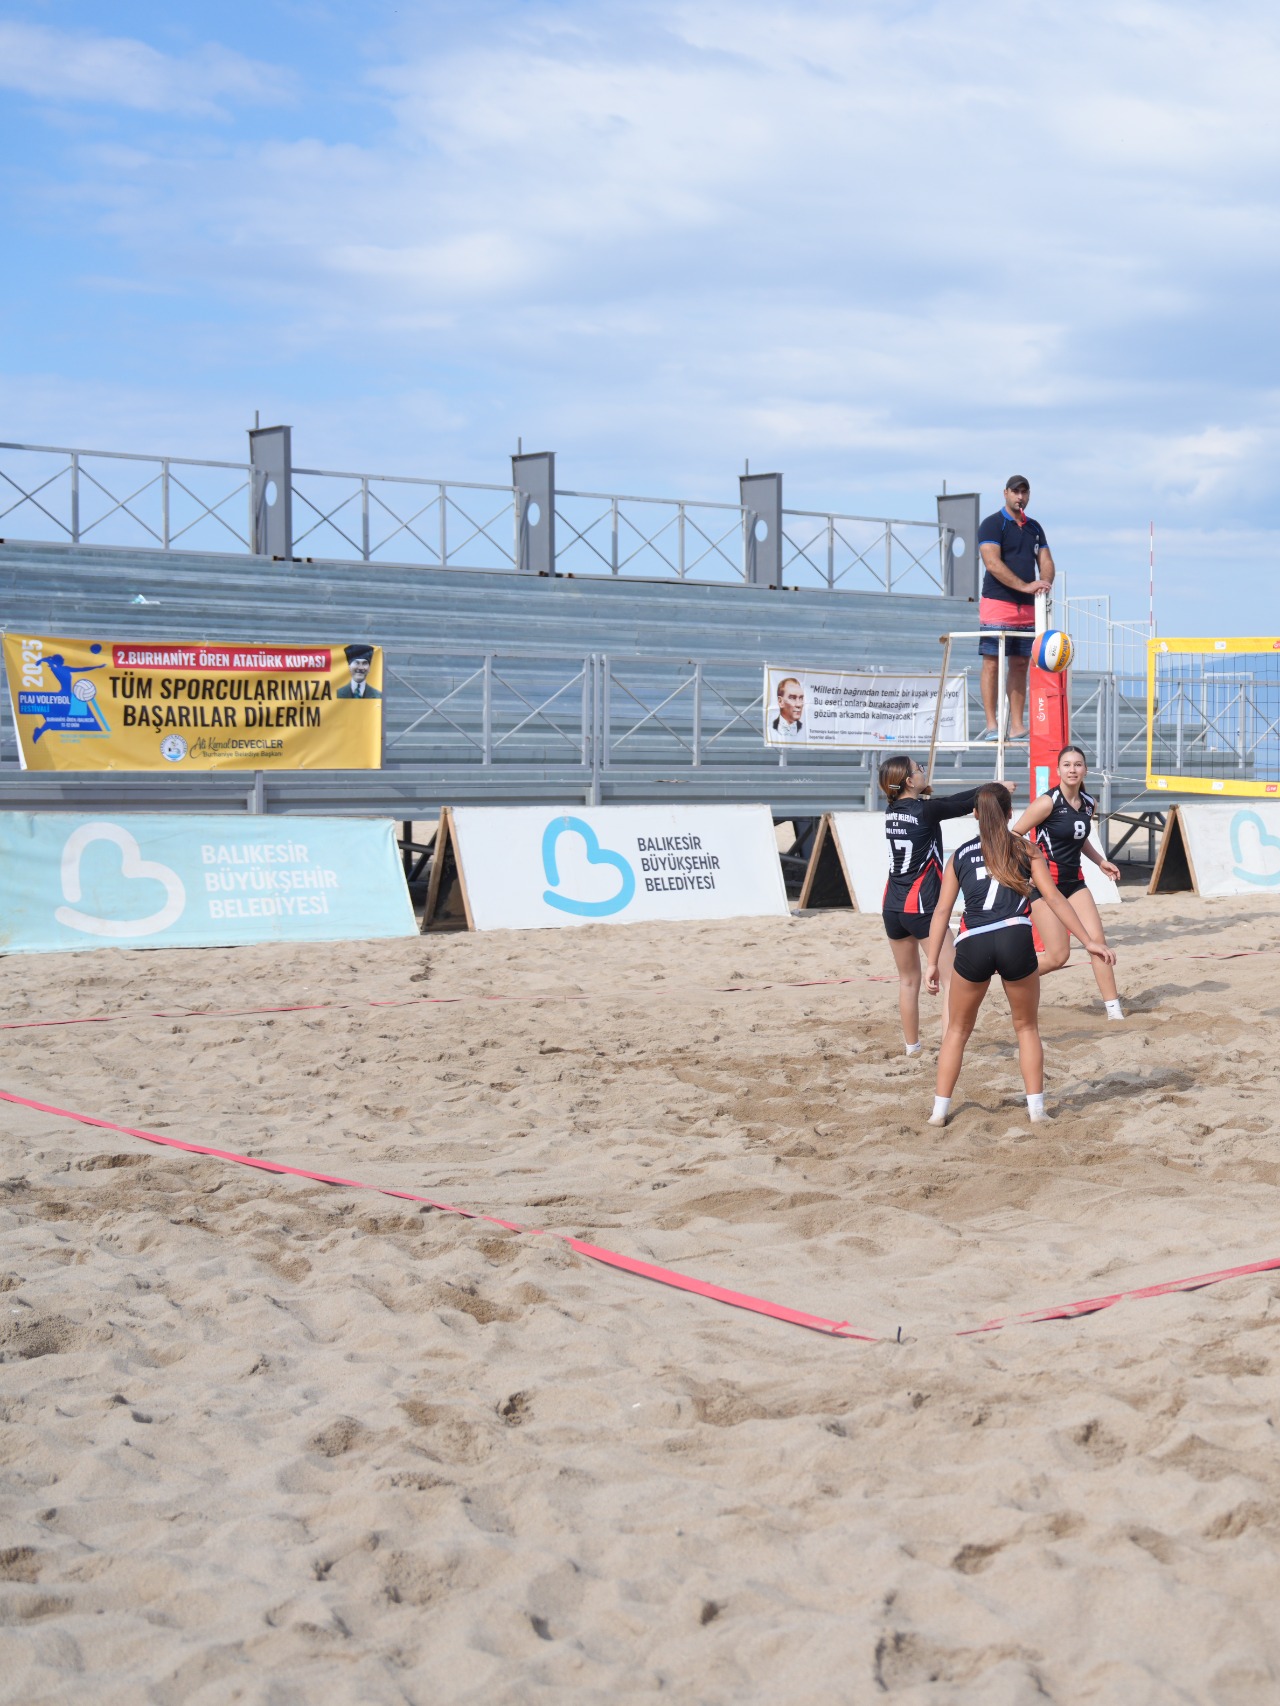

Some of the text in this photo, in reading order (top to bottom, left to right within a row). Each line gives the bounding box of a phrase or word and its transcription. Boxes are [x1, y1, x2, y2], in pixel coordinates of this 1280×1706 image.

[22, 640, 43, 687] 2025
[117, 649, 326, 668] 2.BURHANİYE ÖREN ATATÜRK KUPASI
[109, 671, 332, 701] TÜM SPORCULARIMIZA
[843, 688, 879, 697] bağrından
[881, 689, 900, 697] temiz
[813, 697, 823, 705] Bu
[123, 701, 321, 733] BAŞARILAR DİLERİM
[813, 710, 838, 719] gözüm
[838, 711, 870, 719] arkamda
[1073, 820, 1086, 840] 8
[200, 839, 310, 865] BALIKESİR
[637, 832, 702, 852] BALIKESİR
[640, 852, 721, 874] BÜYÜKŞEHİR
[203, 864, 340, 894] BÜYÜKŞEHİR
[644, 871, 716, 892] BELEDİYESİ
[975, 866, 1000, 911] 7
[208, 891, 330, 919] BELEDİYESİ
